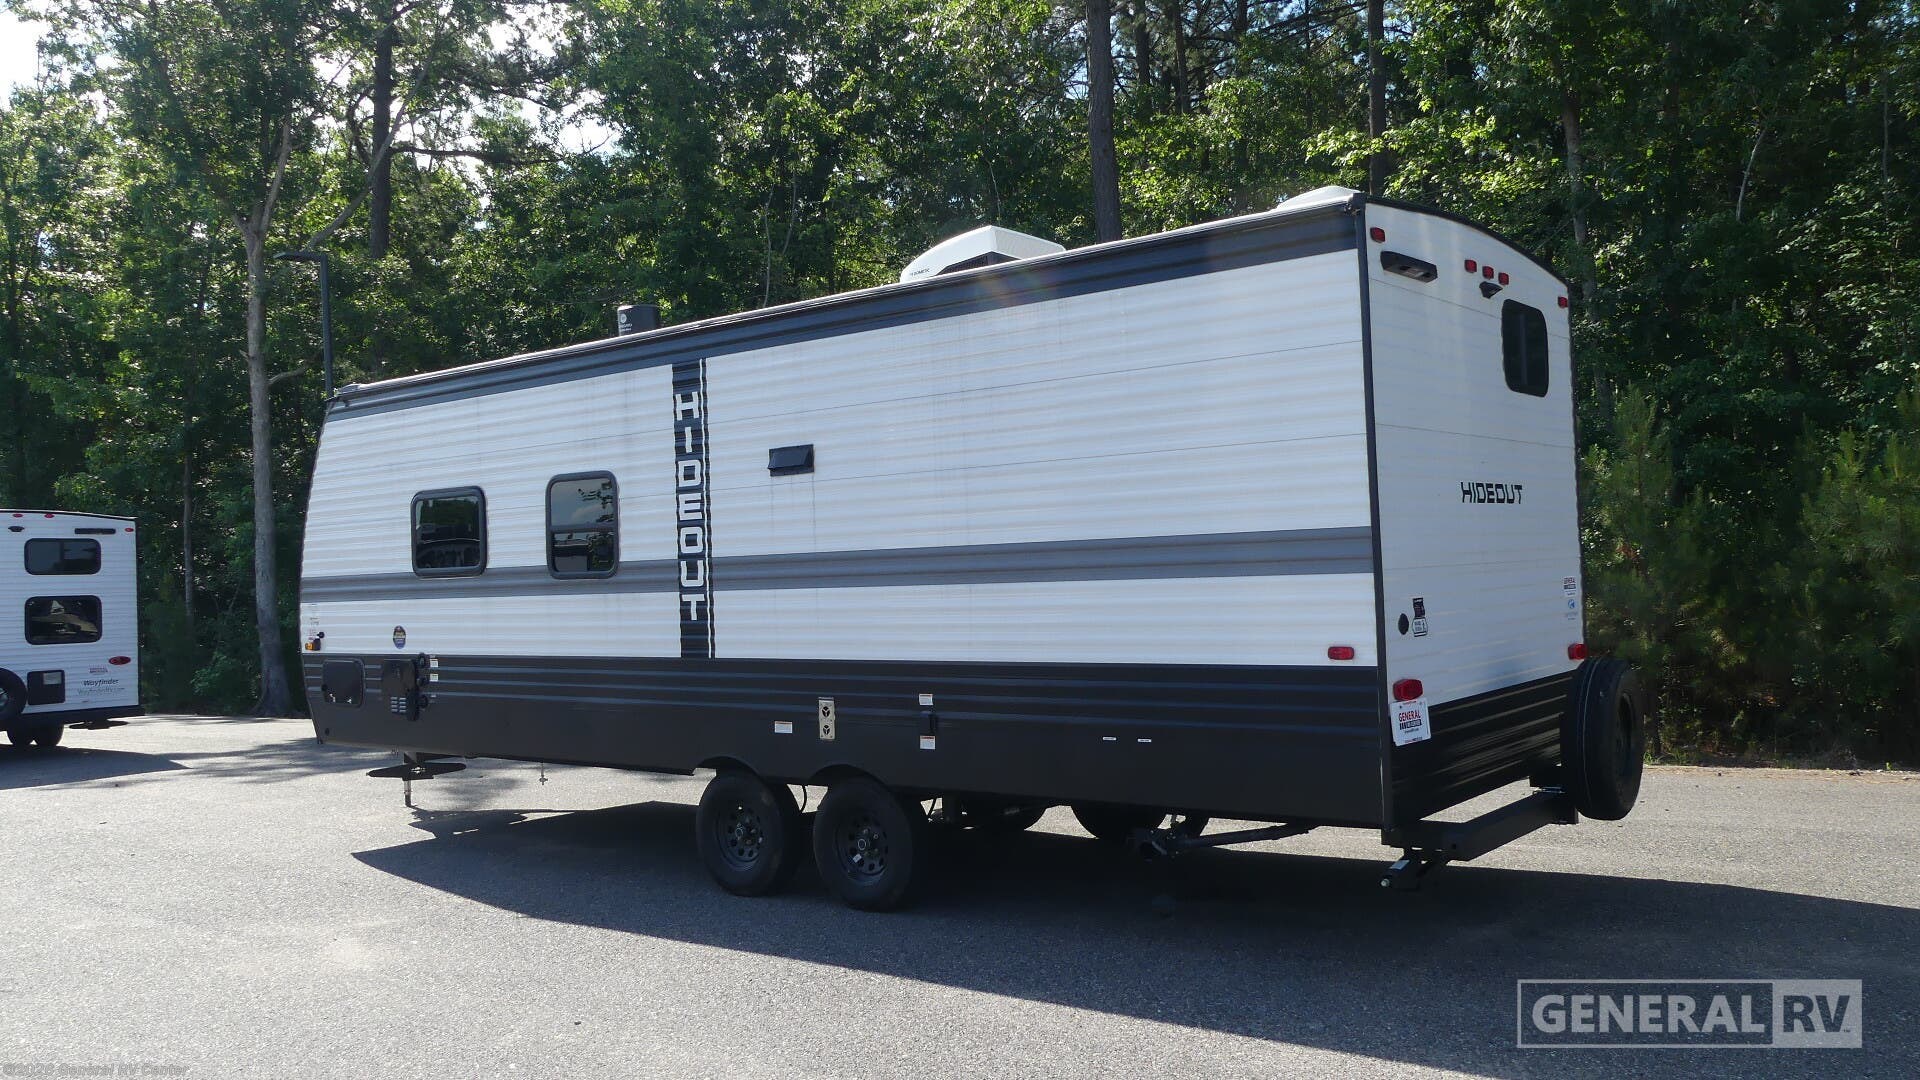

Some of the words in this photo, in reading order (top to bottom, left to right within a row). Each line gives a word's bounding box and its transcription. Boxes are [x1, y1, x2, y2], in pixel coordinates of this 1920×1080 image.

[1460, 481, 1523, 505] HIDEOUT
[674, 391, 705, 621] HIDEOUT
[1398, 709, 1421, 722] GENERAL
